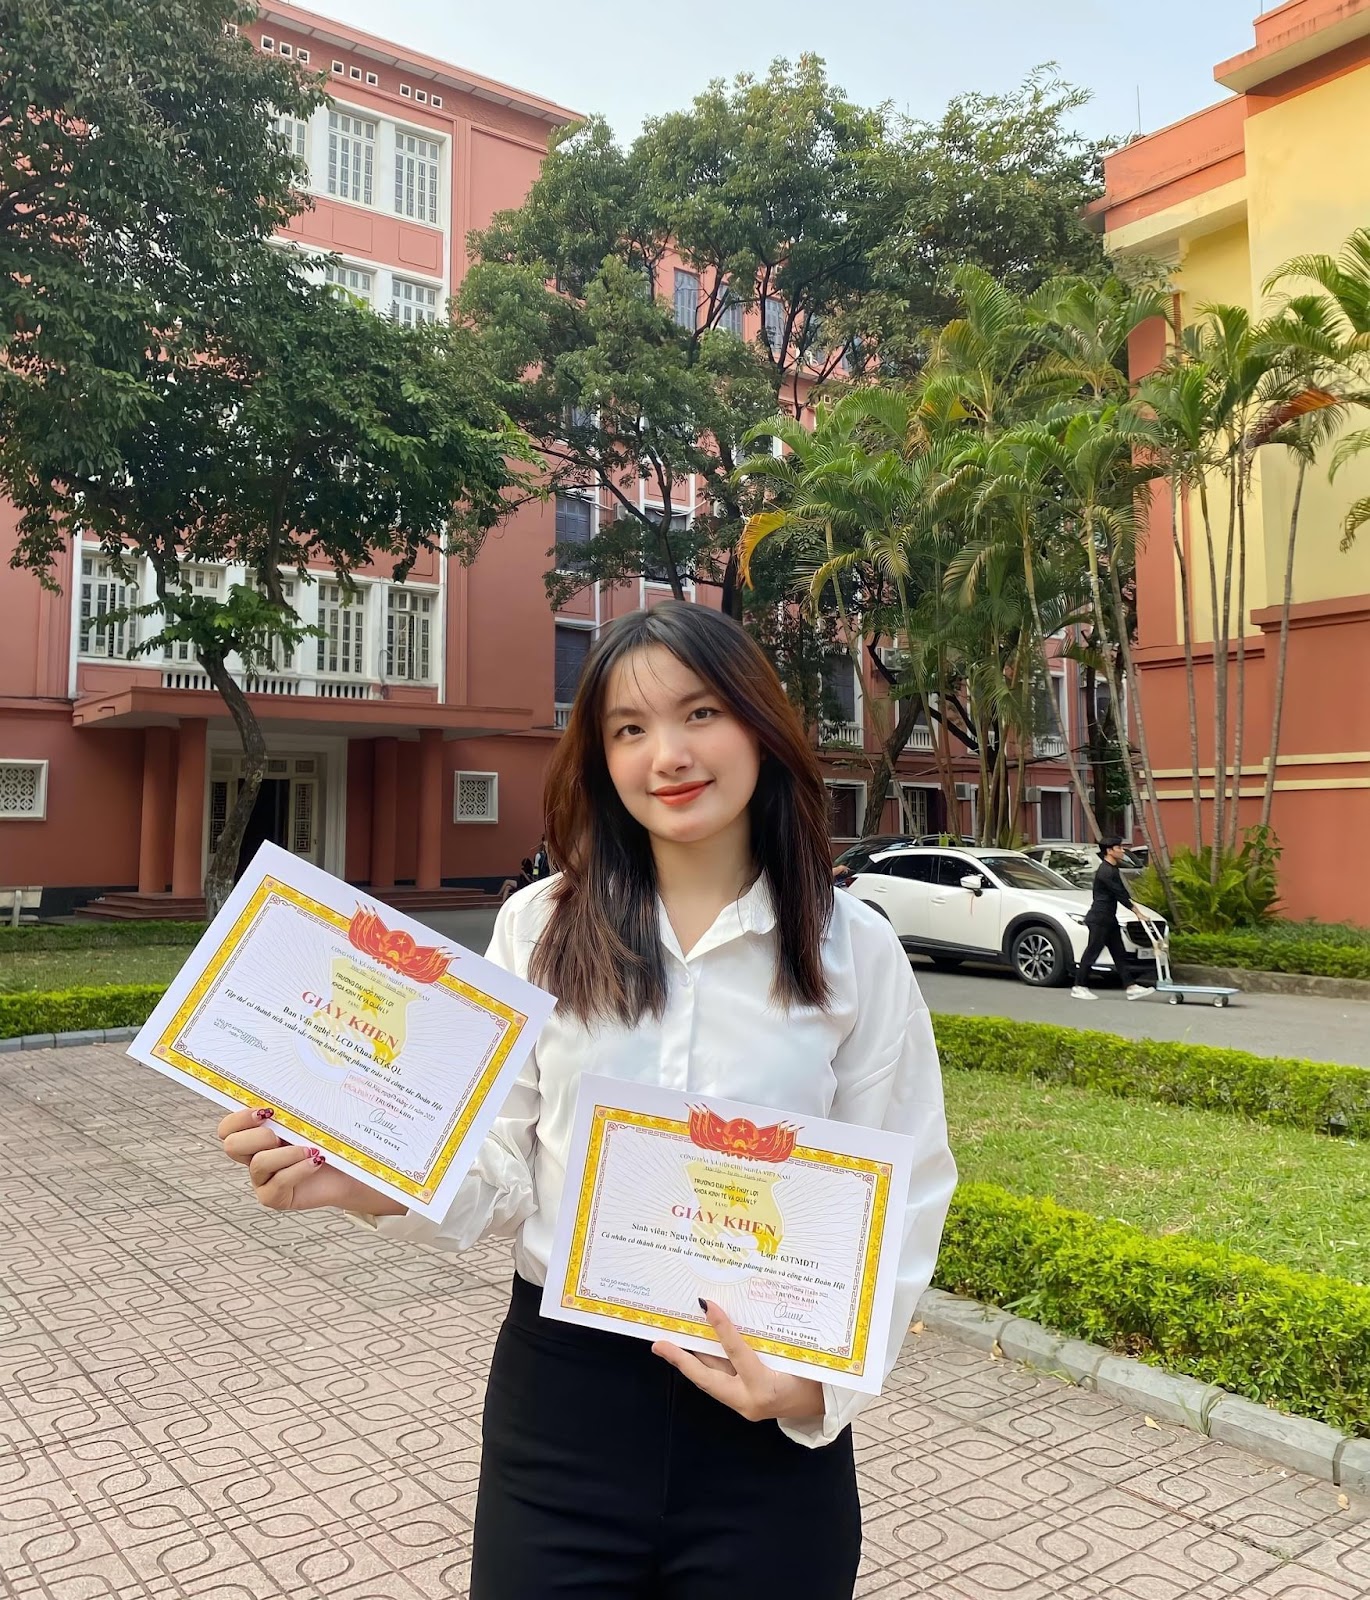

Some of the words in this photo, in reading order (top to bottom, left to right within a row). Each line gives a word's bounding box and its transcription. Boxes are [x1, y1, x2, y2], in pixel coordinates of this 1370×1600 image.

[224, 987, 237, 999] Tập
[306, 1033, 324, 1046] trong
[350, 1057, 371, 1072] phong
[282, 1006, 298, 1018] Ban
[353, 1044, 373, 1059] Khoa
[372, 1055, 403, 1077] KT&QL
[347, 1015, 399, 1050] KHEN
[631, 1222, 648, 1232] Sinh
[650, 1226, 668, 1236] viên:
[669, 1229, 697, 1243] Nguyễn
[726, 1243, 741, 1253] Nga
[723, 1215, 776, 1237] KHEN
[610, 1233, 626, 1242] nhân
[694, 1251, 710, 1260] trong
[743, 1262, 762, 1272] phong
